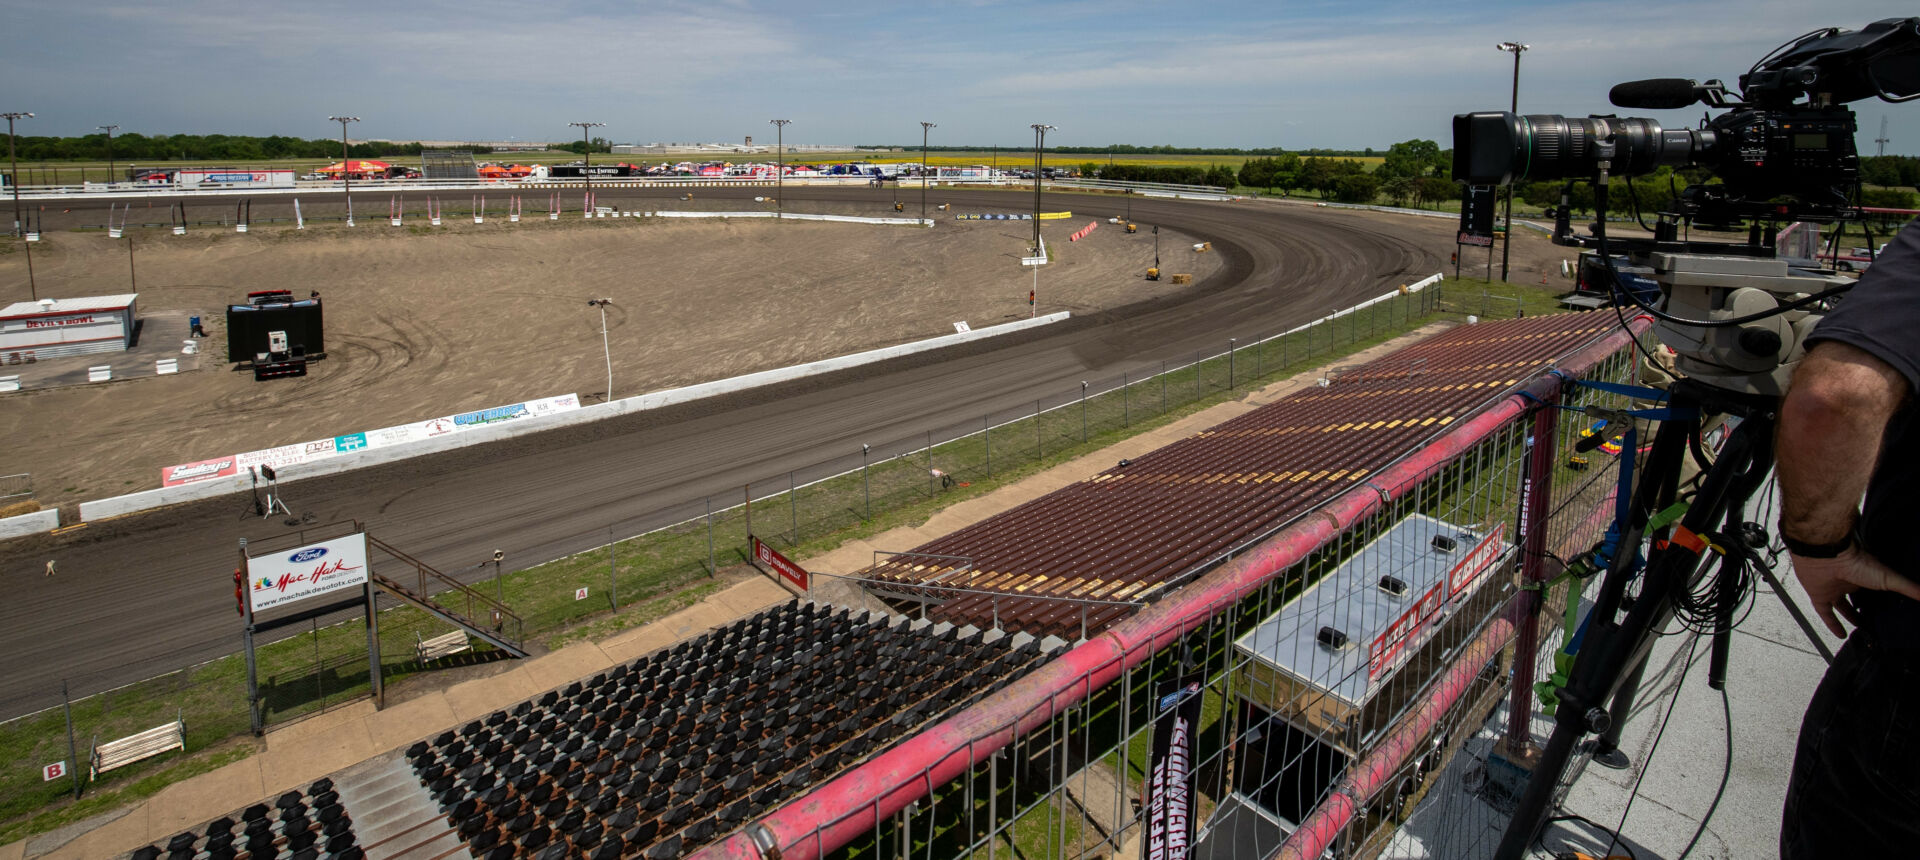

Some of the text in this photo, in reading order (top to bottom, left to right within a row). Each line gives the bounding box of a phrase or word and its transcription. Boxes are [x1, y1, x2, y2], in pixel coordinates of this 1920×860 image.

[66, 315, 95, 325] BOWL
[295, 548, 322, 562] Ford
[274, 559, 352, 592] Mac Haik
[772, 556, 801, 580] GRAVELY
[256, 575, 364, 608] www.machaikdesototx.com
[578, 589, 586, 599] A
[48, 764, 61, 778] B
[1149, 716, 1189, 860] OFFICIAL ERCHANDISE
